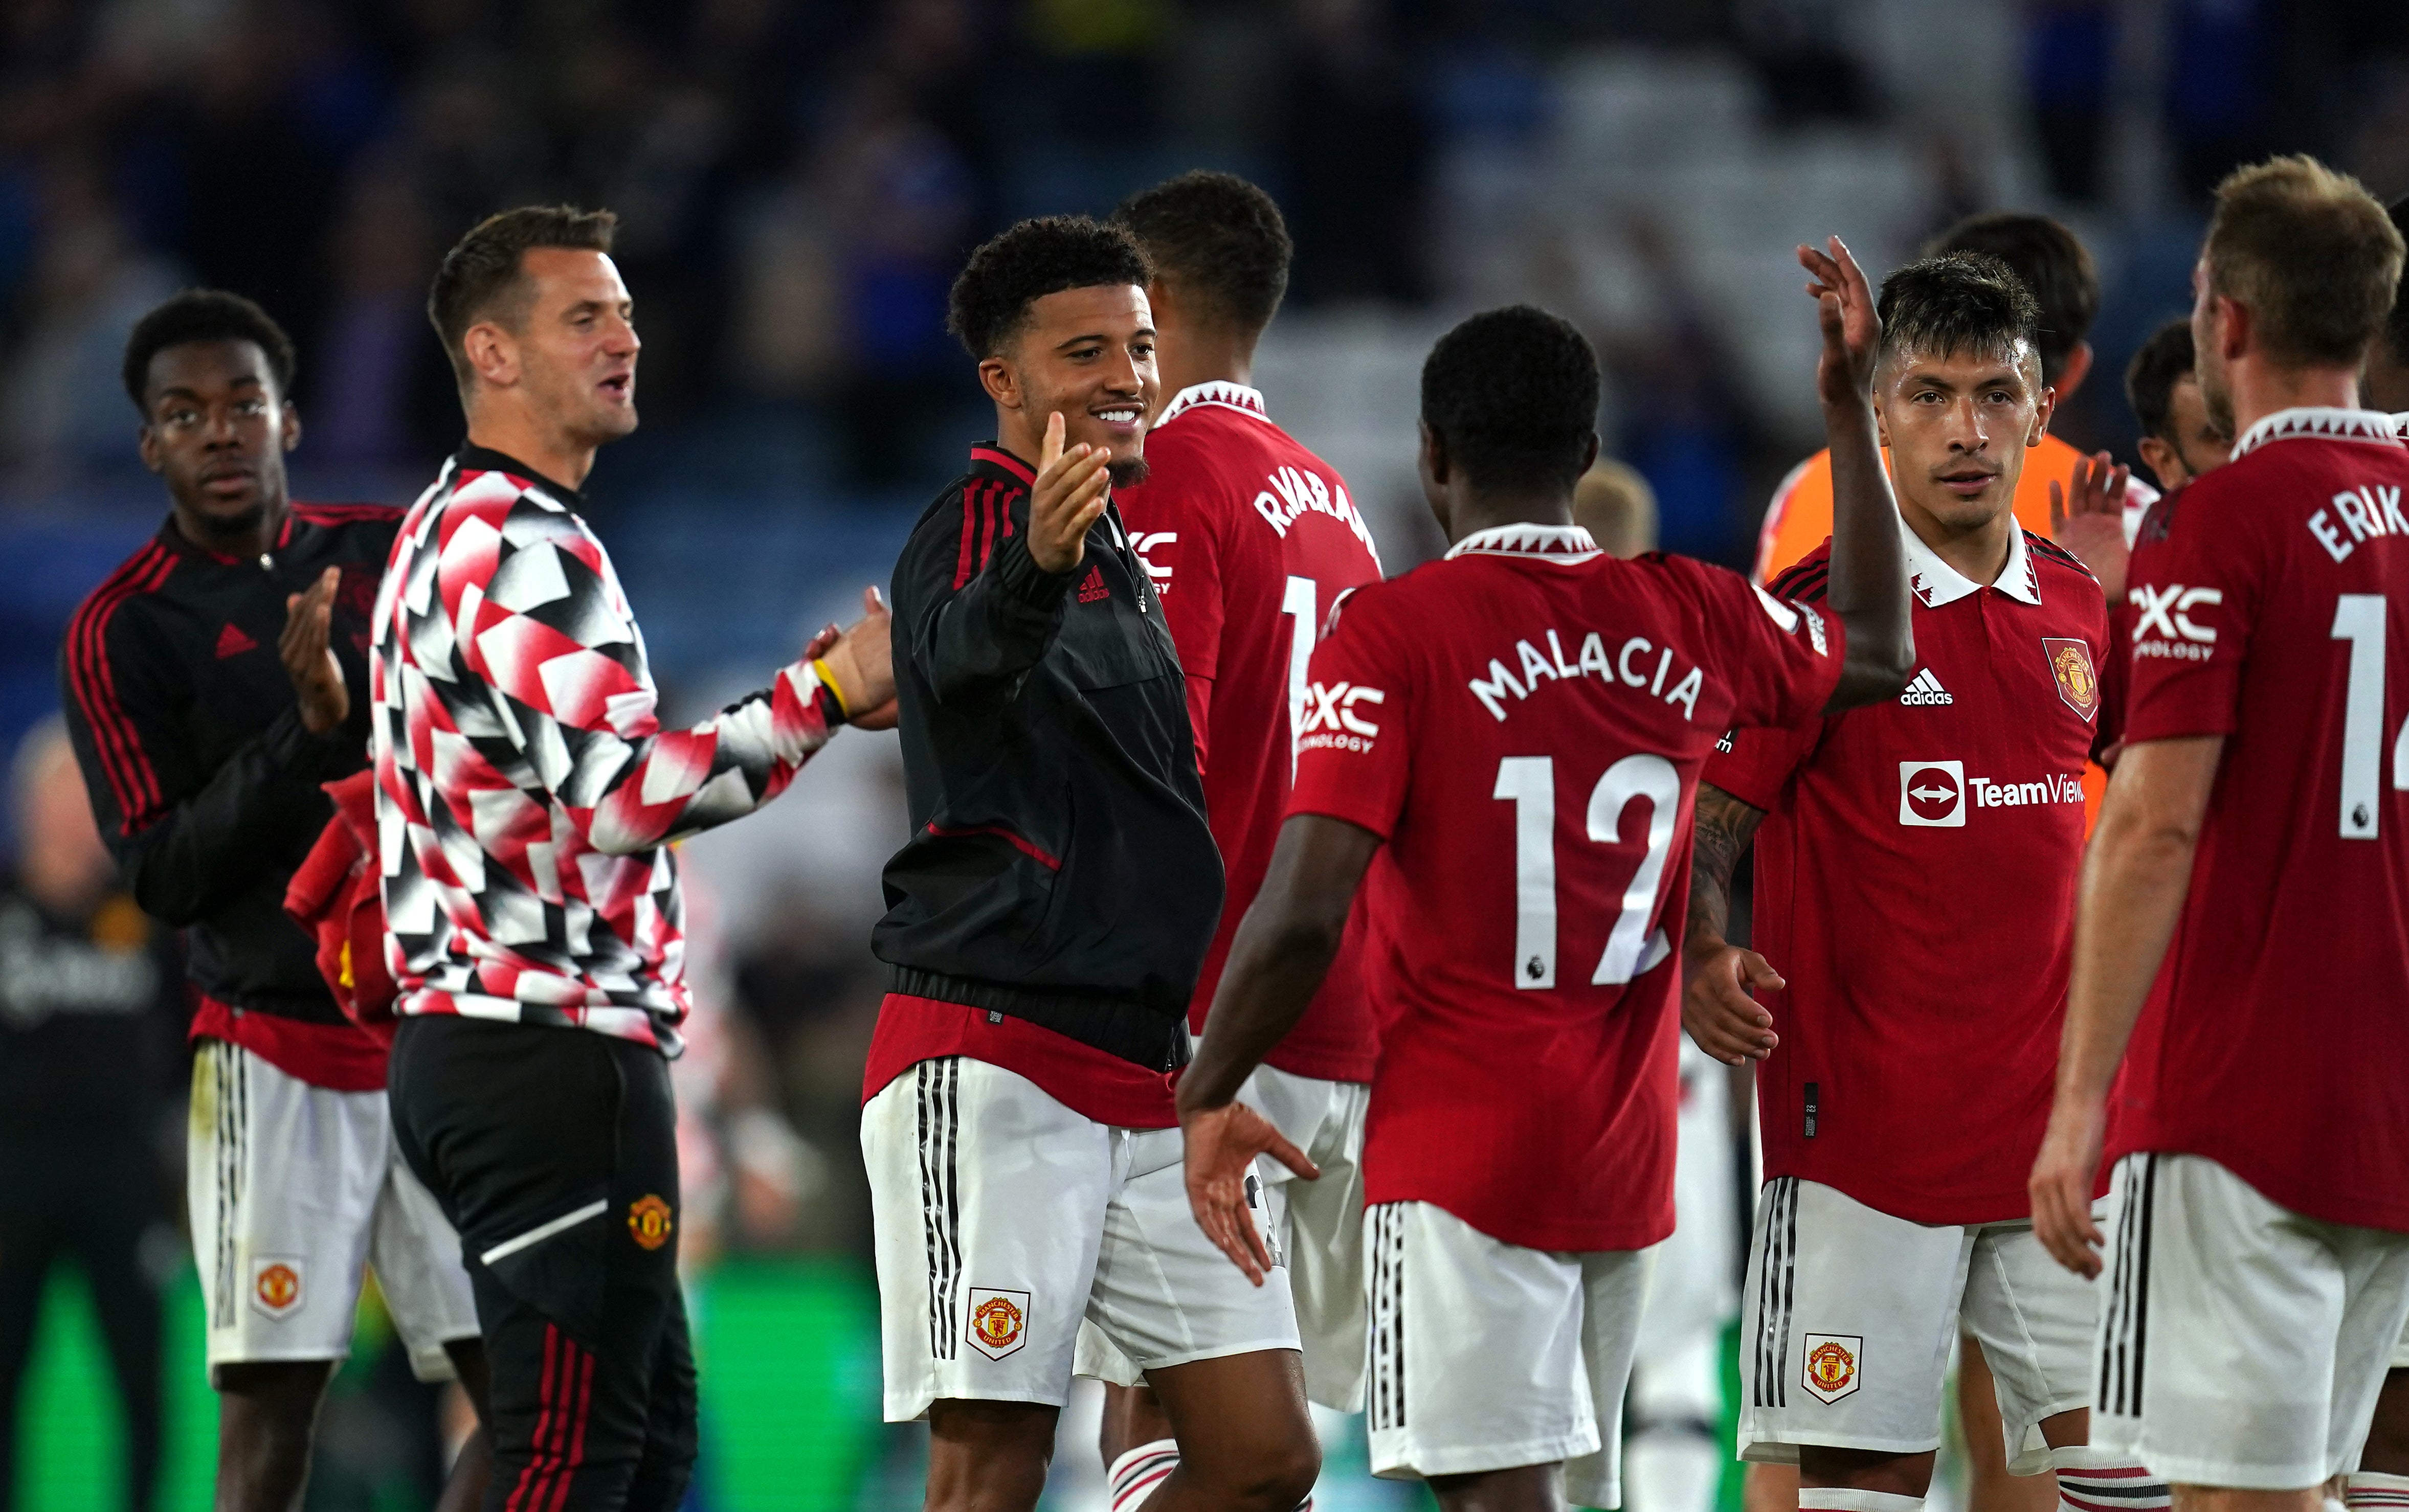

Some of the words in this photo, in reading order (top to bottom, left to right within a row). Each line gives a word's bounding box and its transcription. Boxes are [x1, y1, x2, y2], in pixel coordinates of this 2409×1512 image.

[1254, 466, 1383, 581] R.VARAN
[1468, 628, 1703, 723] MALACIA
[1901, 691, 1953, 705] adidas
[2072, 691, 2091, 703] UNITED
[2330, 594, 2409, 840] 1
[1493, 753, 1681, 990] 12
[979, 1301, 1018, 1319] MANCHESTER
[983, 1335, 1011, 1345] UNITED
[1813, 1346, 1850, 1363] MANCHESTER
[1817, 1380, 1843, 1389] UNITED
